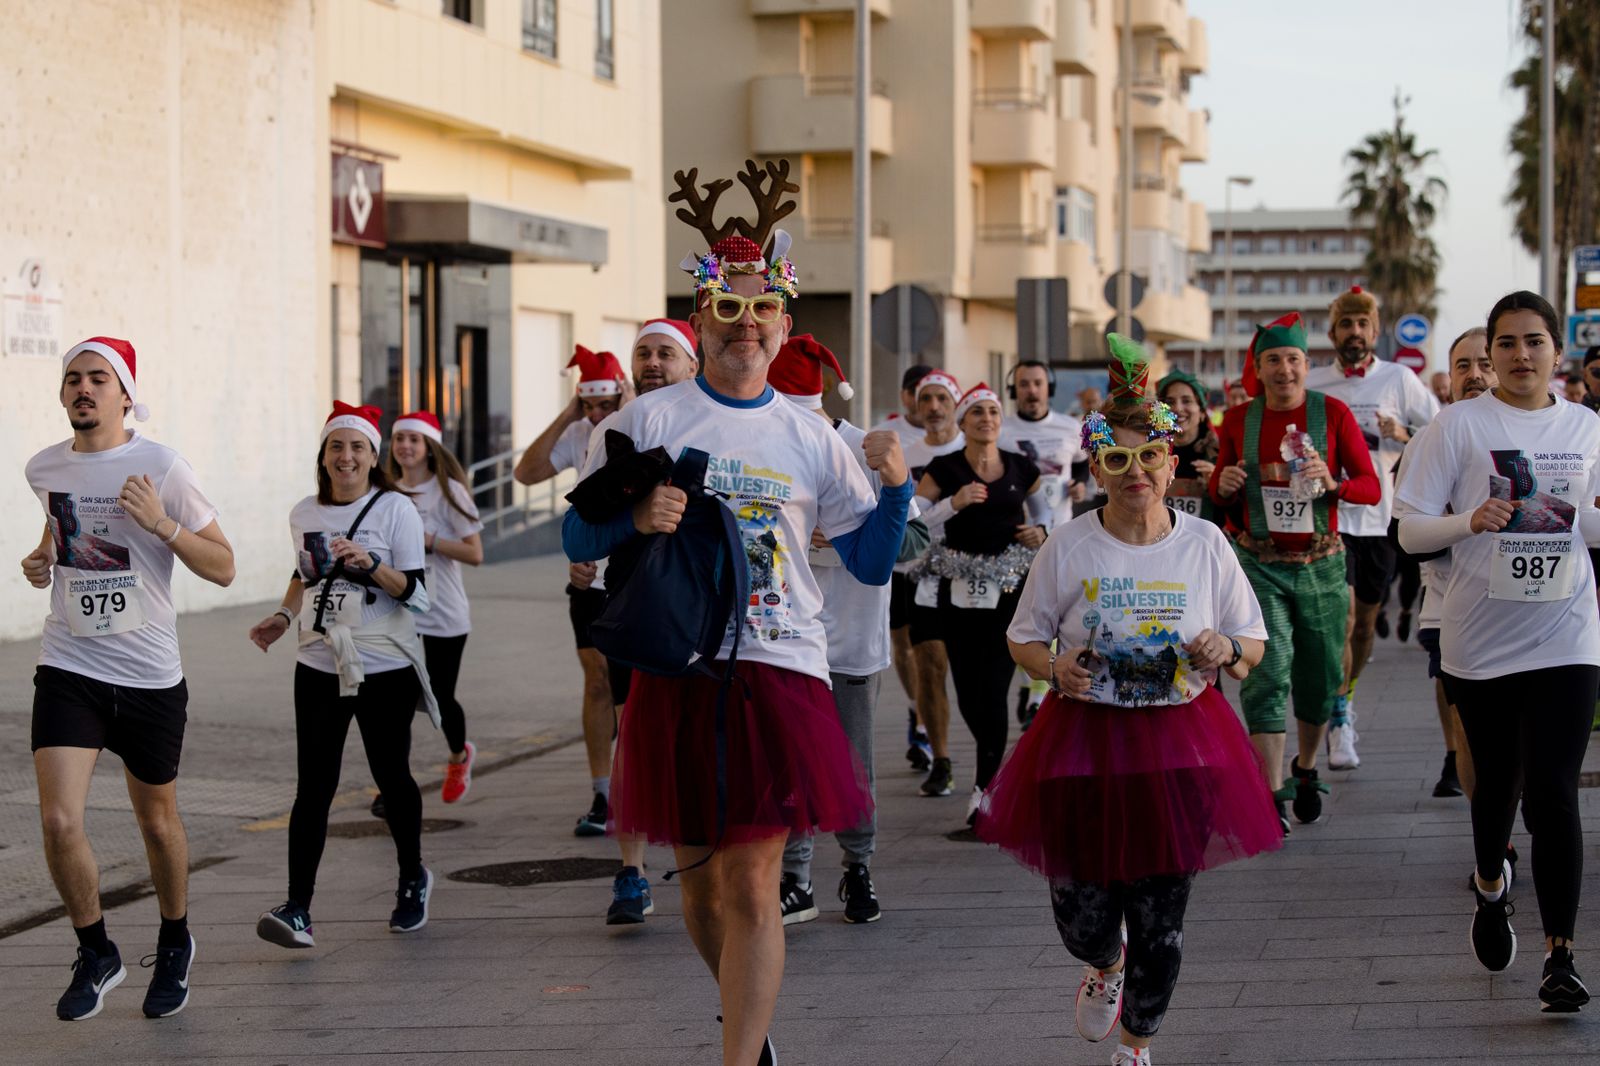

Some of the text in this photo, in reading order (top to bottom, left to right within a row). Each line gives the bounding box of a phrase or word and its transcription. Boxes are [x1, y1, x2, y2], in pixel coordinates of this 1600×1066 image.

[1550, 453, 1584, 461] SILVESTRE
[708, 457, 741, 474] SAN
[1535, 462, 1559, 471] CIUDAD
[1560, 463, 1569, 471] DE
[708, 474, 791, 499] SILVESTRE
[80, 496, 119, 505] SAN SILVEST
[1165, 497, 1196, 514] 936
[79, 505, 100, 514] CIUDAD
[100, 506, 108, 514] DE
[1273, 501, 1308, 517] 937
[1499, 545, 1534, 554] CIUDAD
[1511, 556, 1561, 580] 987
[69, 584, 97, 593] CIUDAD
[99, 583, 110, 591] DE
[70, 575, 136, 587] SAN SILVESTRE
[967, 580, 987, 595] 35
[1101, 577, 1134, 591] SAN
[1081, 577, 1099, 602] V
[80, 591, 126, 616] 979
[1101, 592, 1187, 609] SILVESTRE
